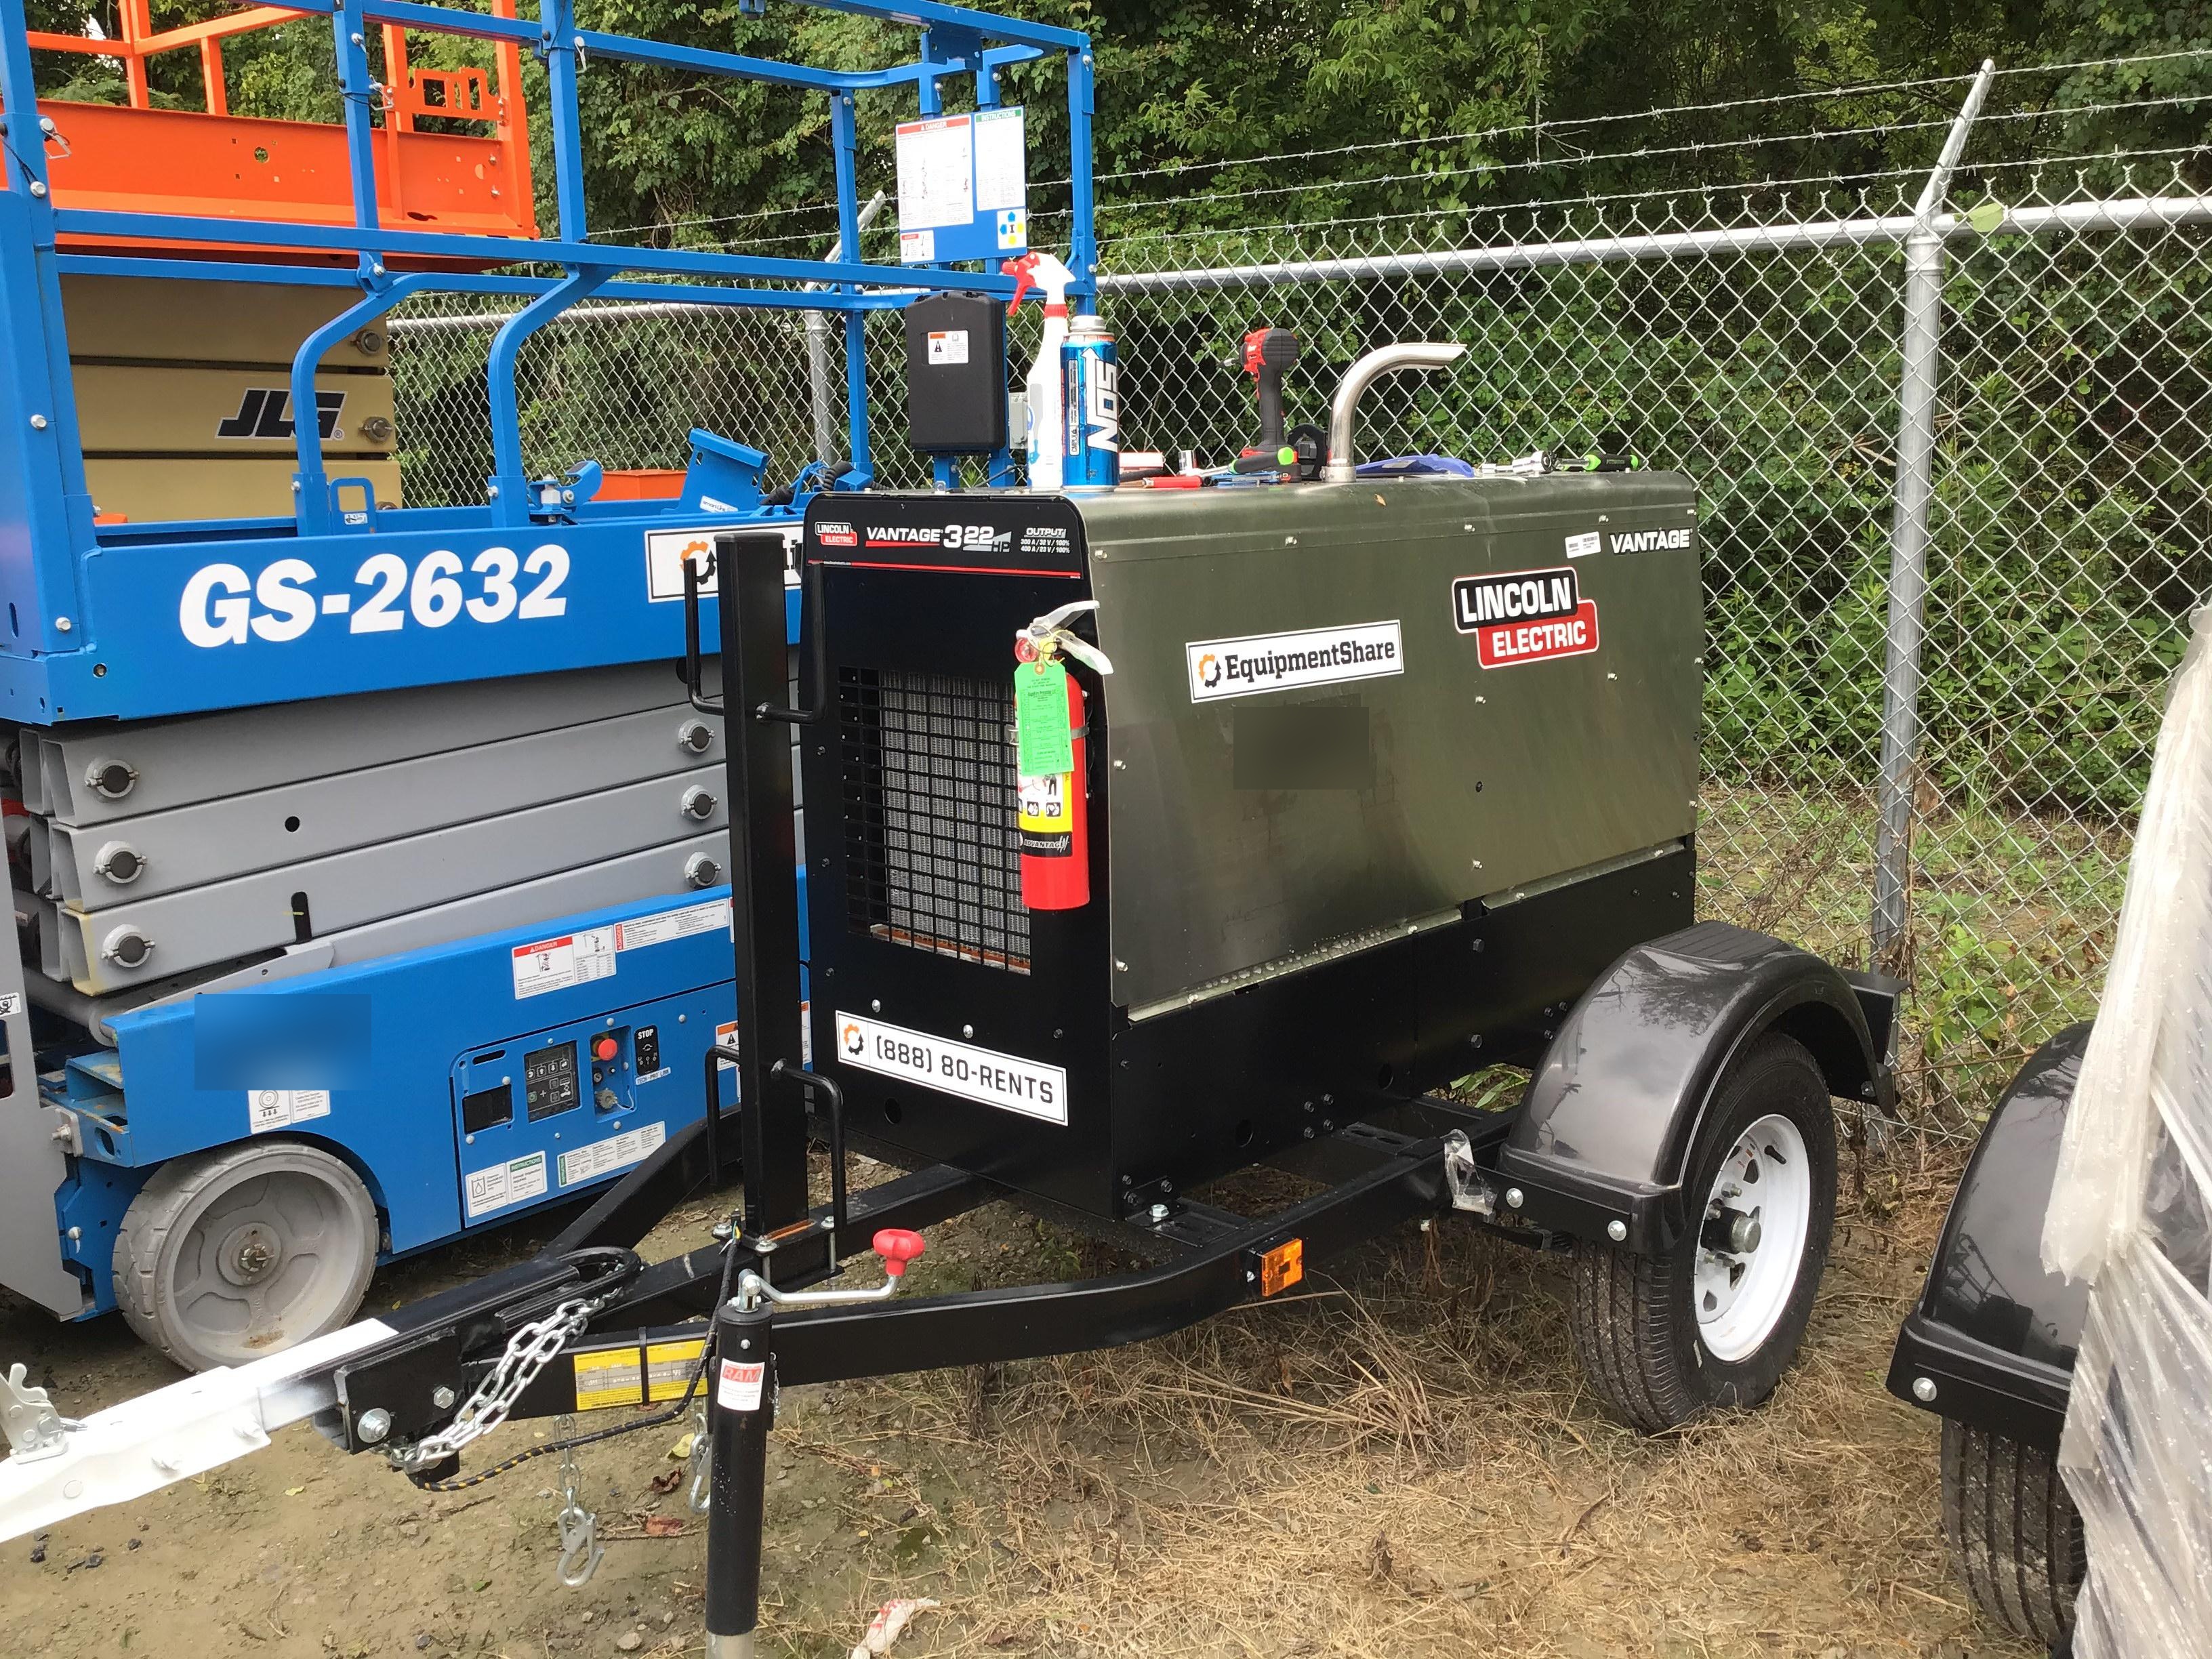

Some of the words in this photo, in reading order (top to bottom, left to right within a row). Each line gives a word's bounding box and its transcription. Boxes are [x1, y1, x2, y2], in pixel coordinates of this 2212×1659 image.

[926, 121, 947, 129] DANGER
[1083, 348, 1119, 453] NOS
[817, 525, 849, 534] LINCOLN
[866, 527, 940, 542] VANTAGE
[1026, 528, 1064, 536] OUTPUT
[1610, 529, 1690, 554] VANTAGE
[179, 544, 570, 648] GS-2632
[1460, 577, 1572, 623] LINCOLN
[1492, 620, 1587, 658] ELECTRIC
[1225, 640, 1395, 683] EquipmentShare
[535, 941, 558, 951] DANGER
[638, 1028, 654, 1040] STOP
[876, 1035, 933, 1073] (888)
[941, 1054, 1053, 1104] 80-RENTS
[722, 1366, 761, 1382] RAM
